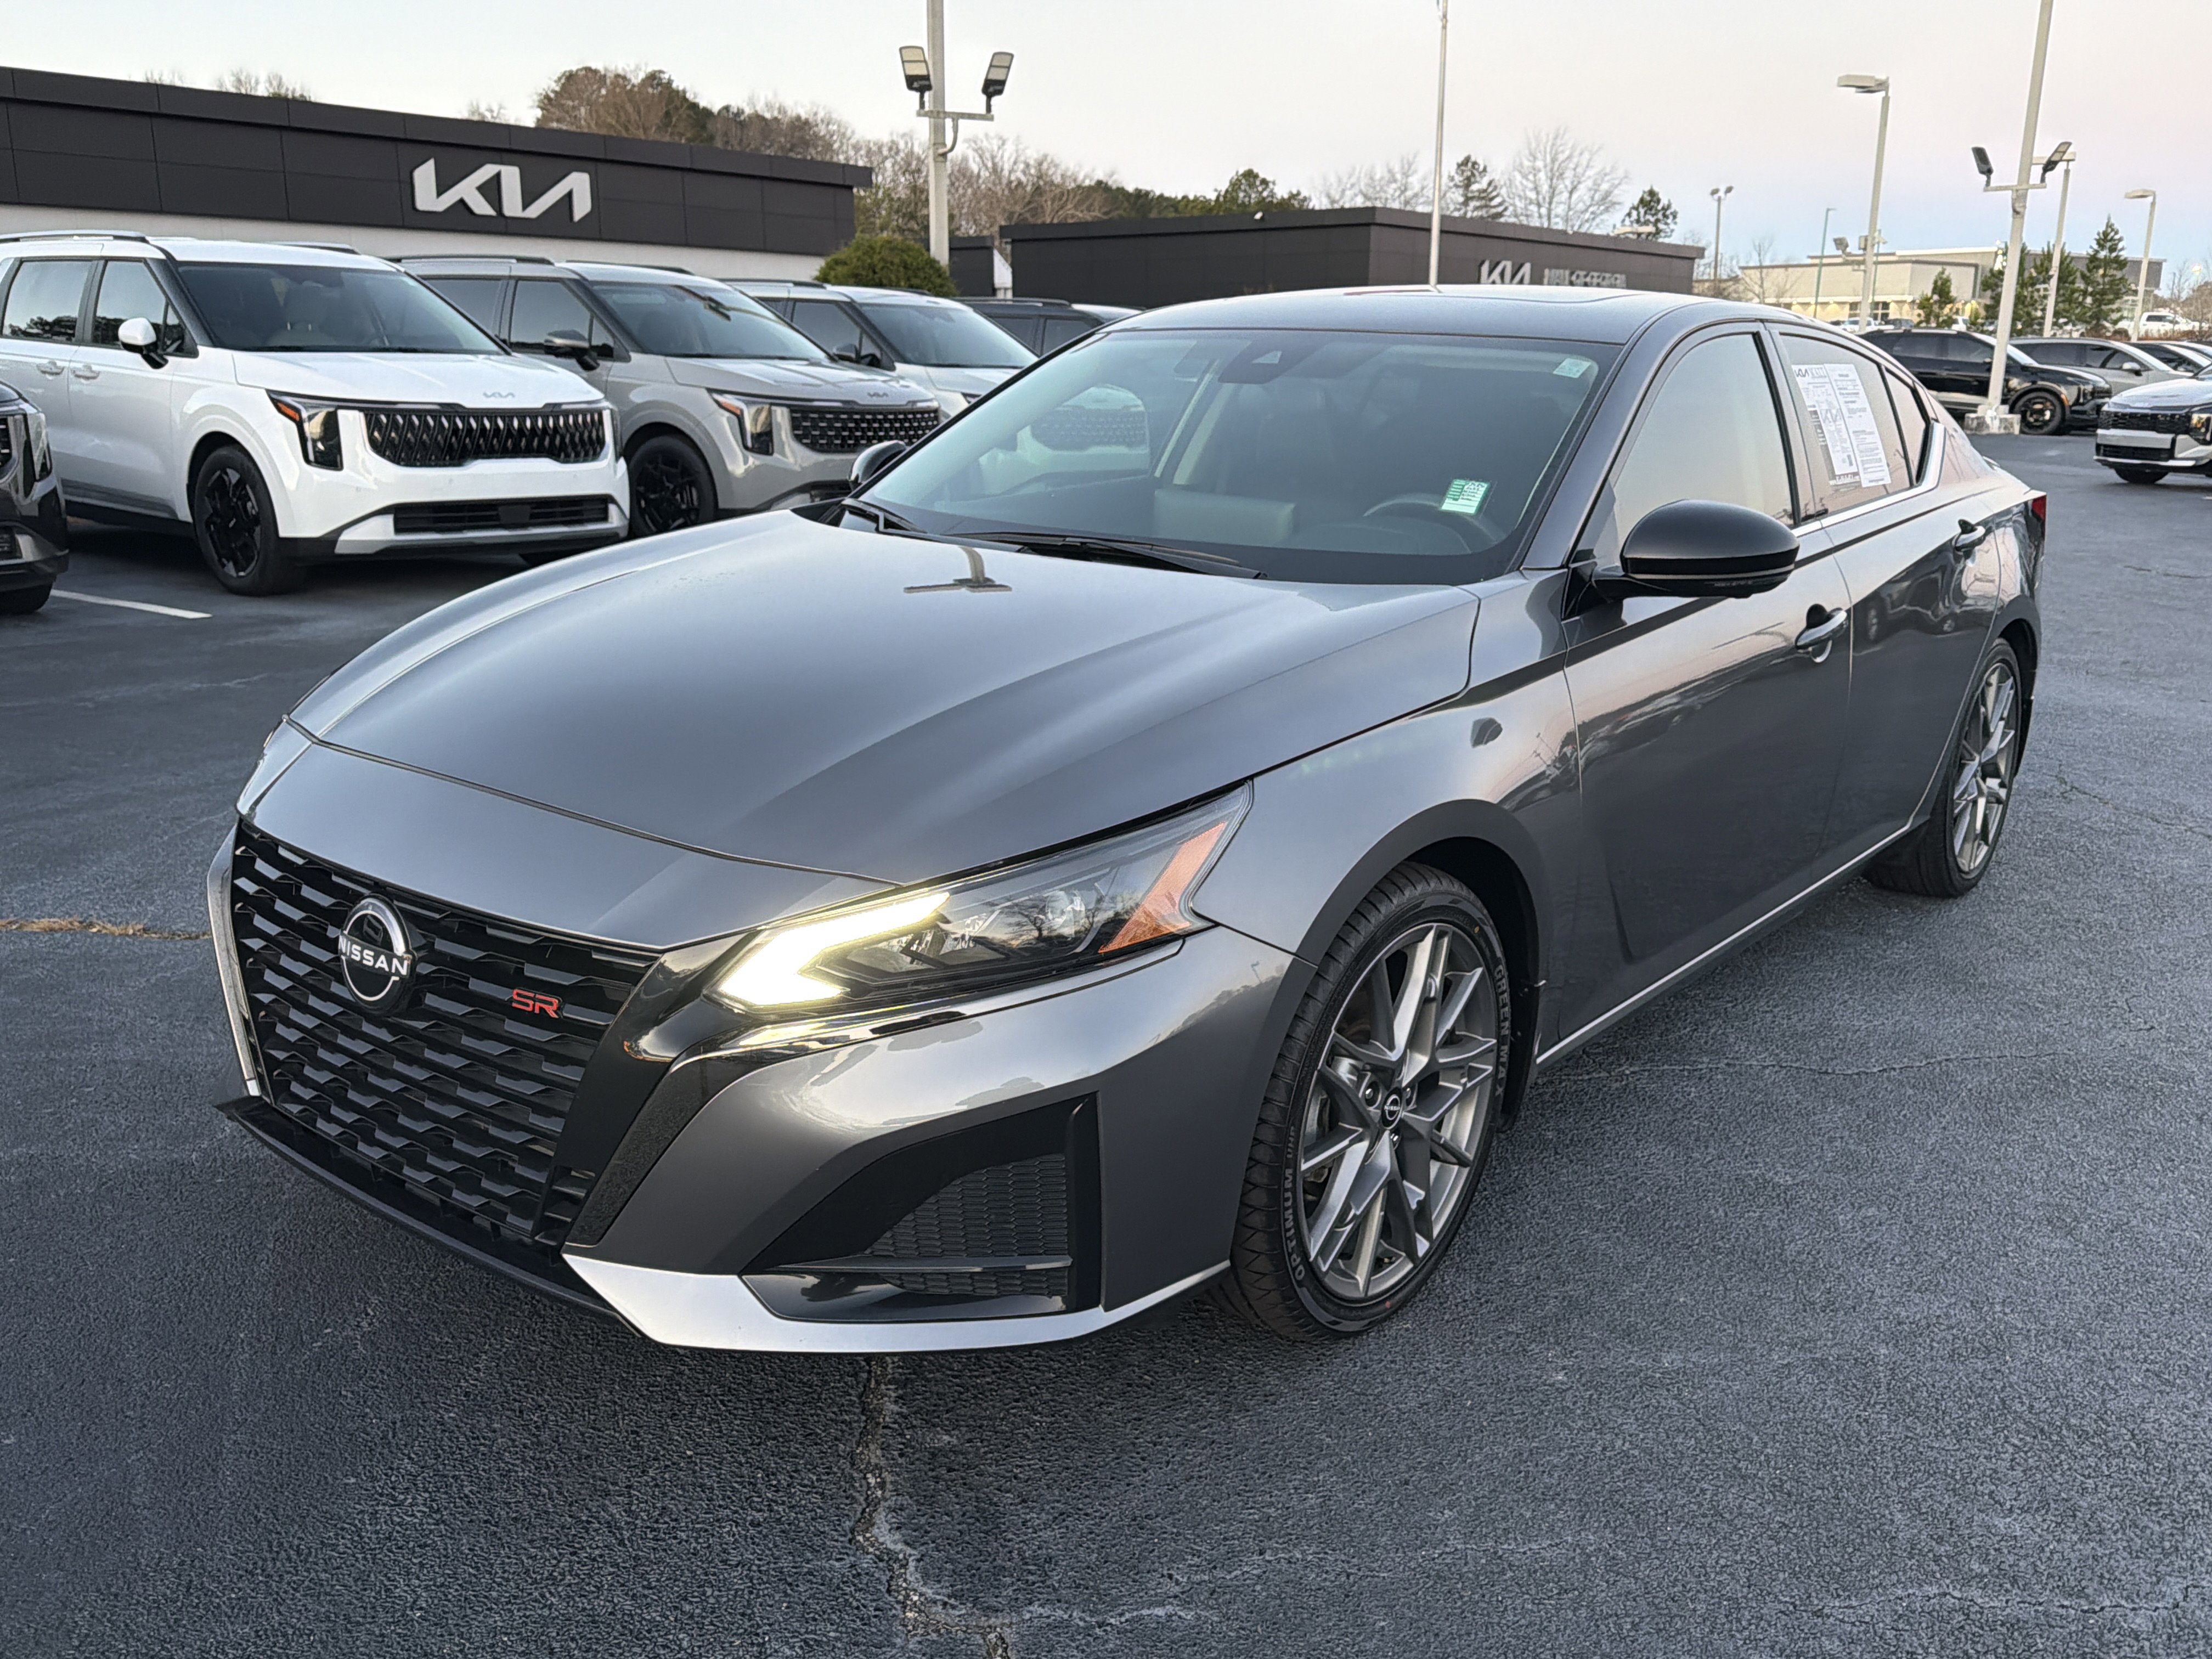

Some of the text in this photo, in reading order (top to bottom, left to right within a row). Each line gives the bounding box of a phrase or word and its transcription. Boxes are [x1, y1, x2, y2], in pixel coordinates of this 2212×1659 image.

[413, 157, 592, 222] KIA
[1480, 259, 1532, 284] KIA
[1794, 368, 1809, 377] KIA
[338, 935, 408, 975] NISSAN
[511, 988, 559, 1019] SR
[1494, 964, 1509, 1097] GREEN MAX
[1284, 1168, 1306, 1281] OPTIMUM
